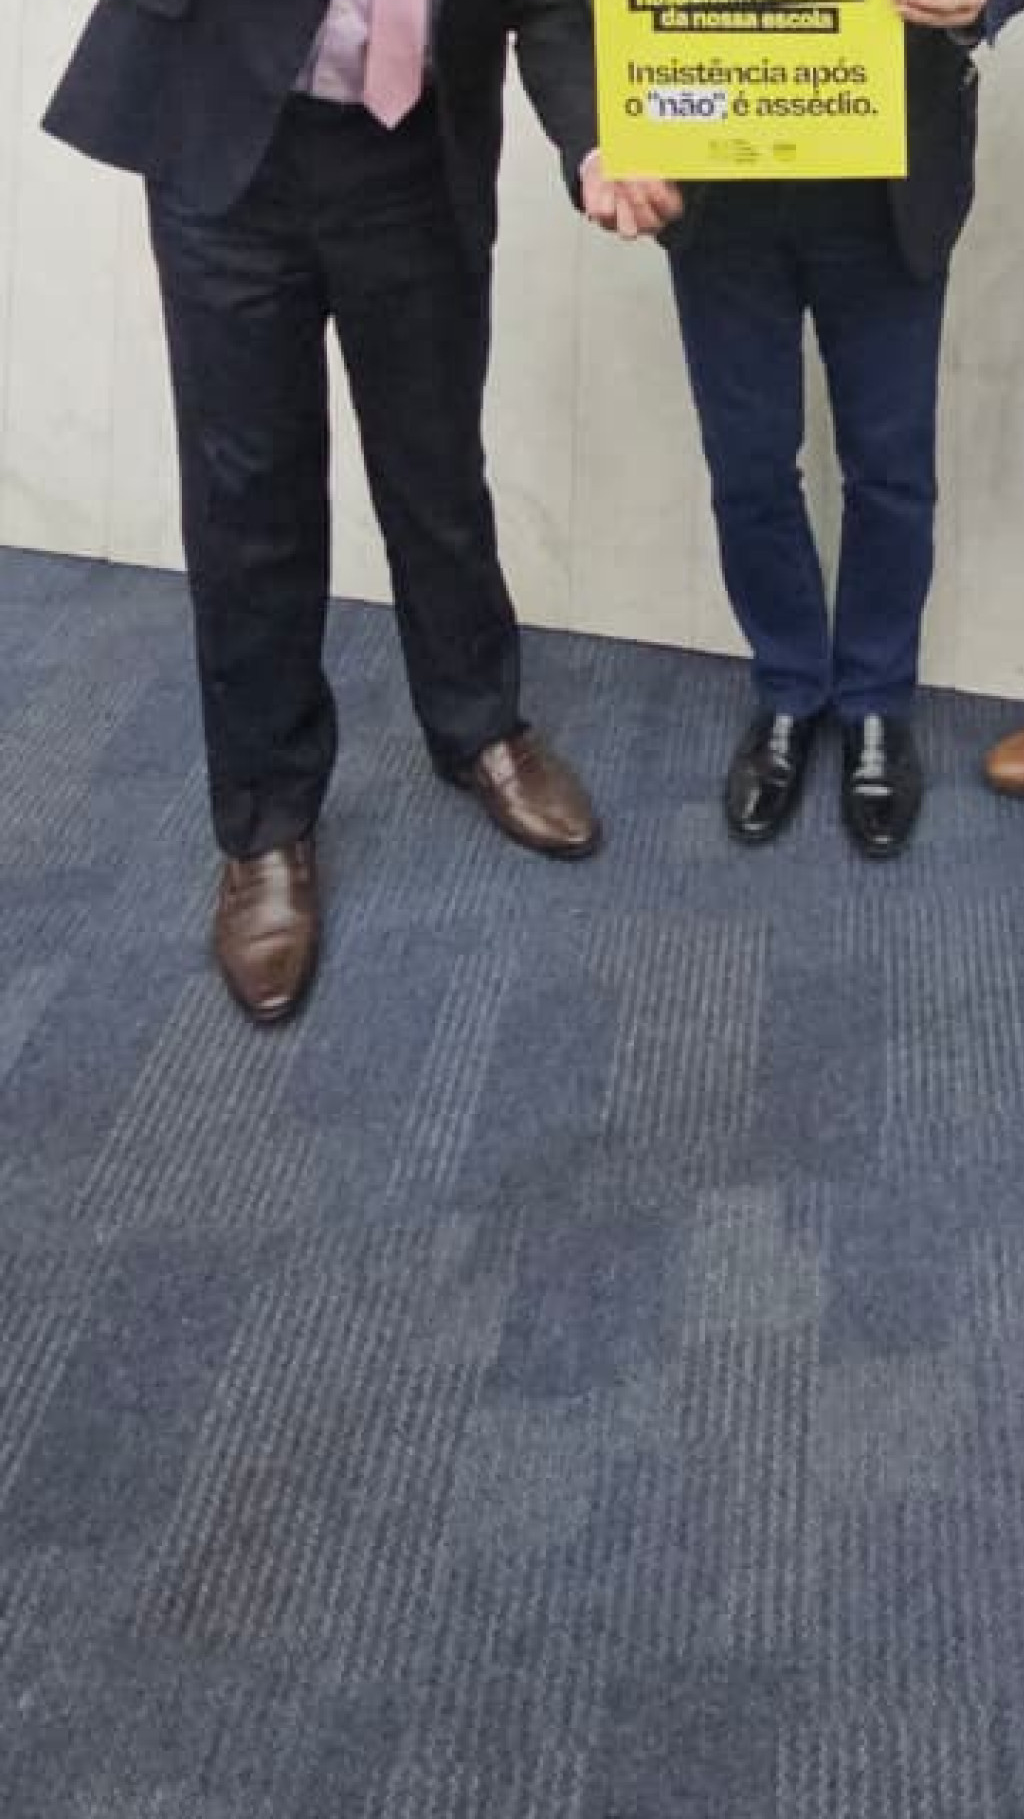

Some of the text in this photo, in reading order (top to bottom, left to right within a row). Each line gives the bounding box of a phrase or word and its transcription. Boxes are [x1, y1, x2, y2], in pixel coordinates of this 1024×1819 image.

[661, 9, 834, 30] da nossa escola
[628, 56, 868, 92] Insistência após
[625, 97, 643, 117] o
[733, 91, 750, 117] é
[755, 89, 880, 117] assédio.
